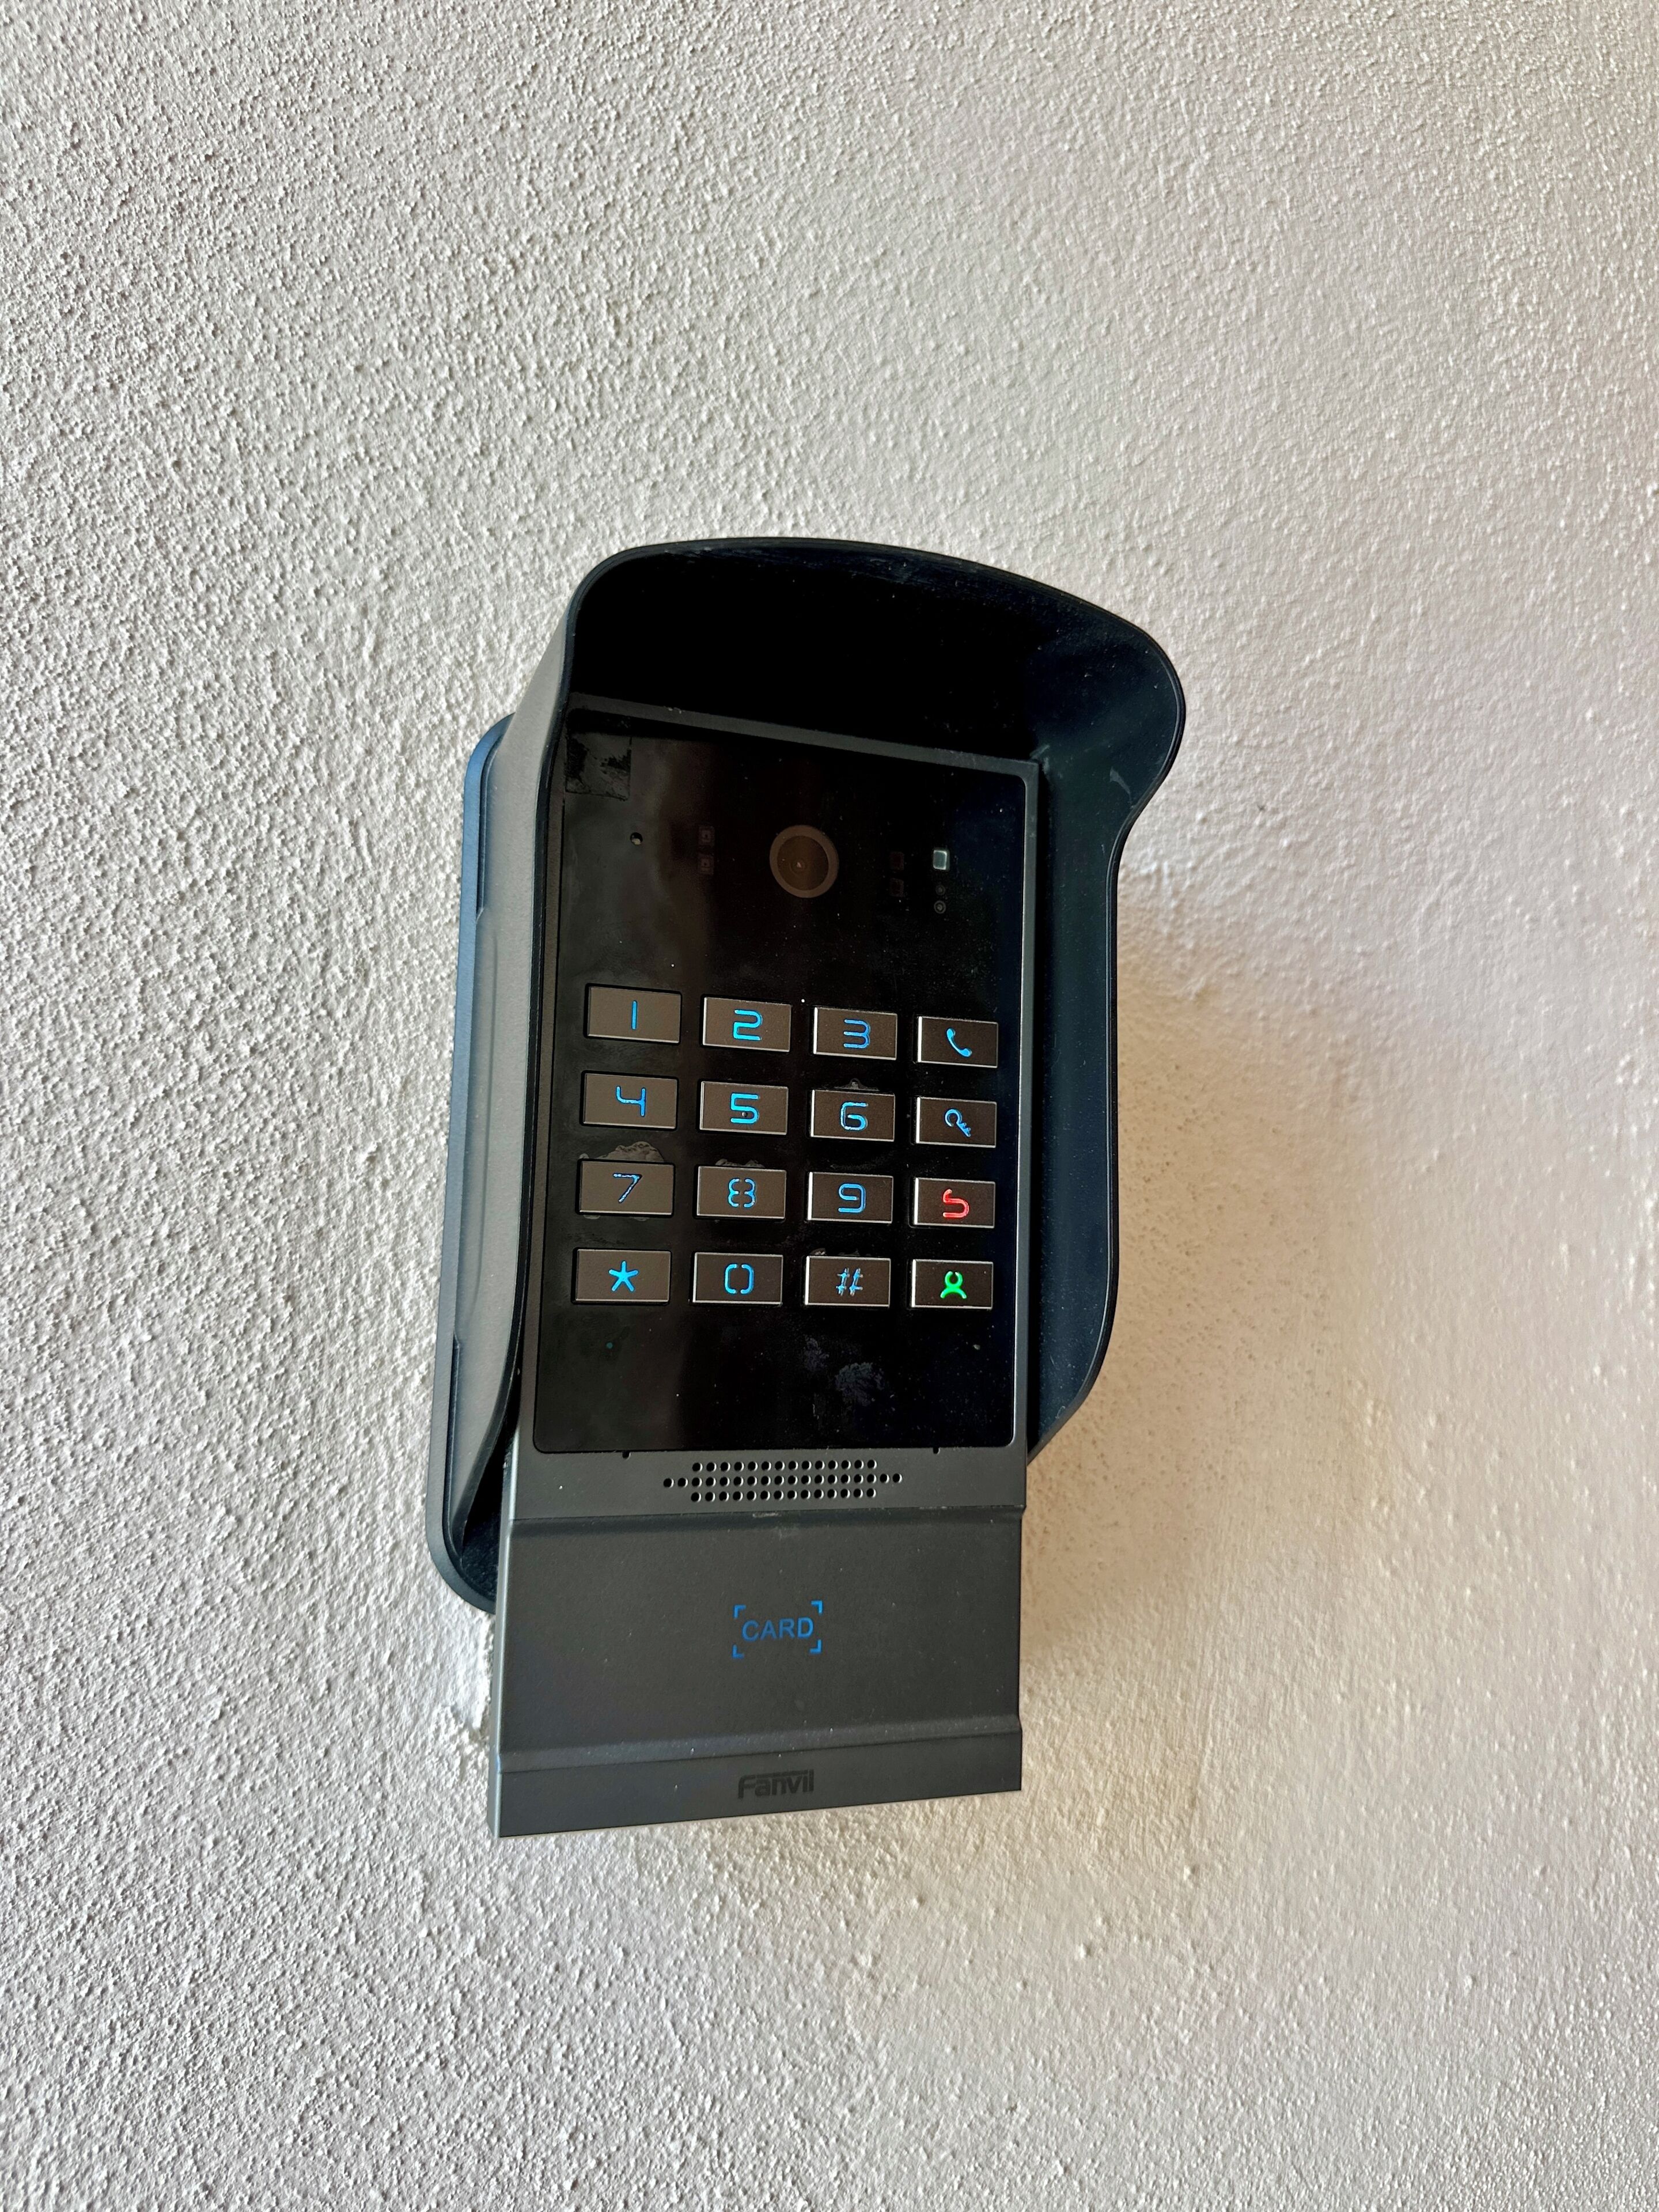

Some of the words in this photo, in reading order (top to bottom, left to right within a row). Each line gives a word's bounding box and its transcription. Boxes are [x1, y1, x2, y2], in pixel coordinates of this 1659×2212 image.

[631, 1001, 637, 1030] 1
[733, 1009, 763, 1041] 2
[844, 1019, 870, 1049] 3
[615, 1086, 646, 1116] 4
[730, 1092, 759, 1124] 5
[840, 1101, 866, 1131] 6
[613, 1173, 642, 1203] 7
[728, 1178, 756, 1209] 8
[838, 1183, 866, 1214] 9
[724, 1263, 755, 1296] 0
[836, 1268, 863, 1296] #
[742, 1616, 813, 1642] CARD
[738, 1769, 815, 1799] Fanvil
